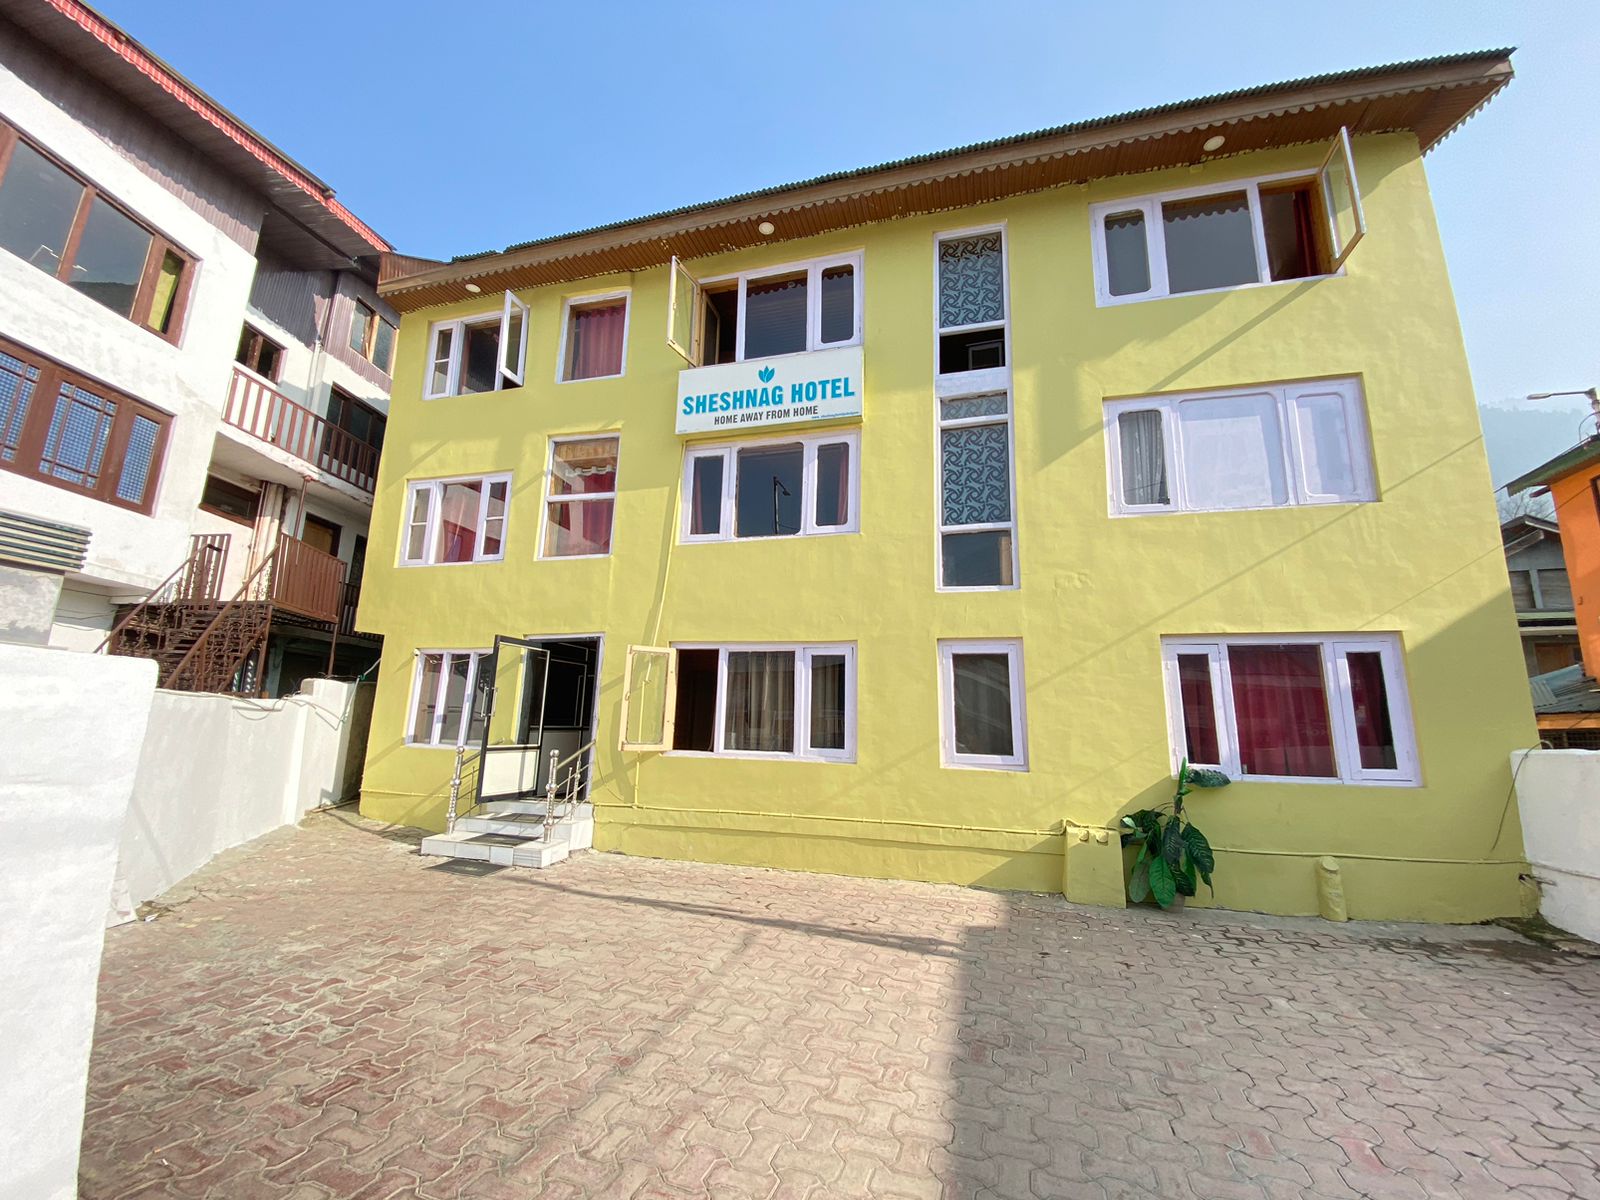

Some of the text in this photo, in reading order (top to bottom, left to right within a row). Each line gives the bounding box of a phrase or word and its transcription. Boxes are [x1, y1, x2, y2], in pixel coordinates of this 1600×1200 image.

[682, 377, 855, 416] SHESHNAG HOTEL
[714, 414, 738, 425] HOME
[740, 411, 764, 423] AWAY
[766, 408, 791, 420] FROM
[793, 405, 819, 417] HOME
